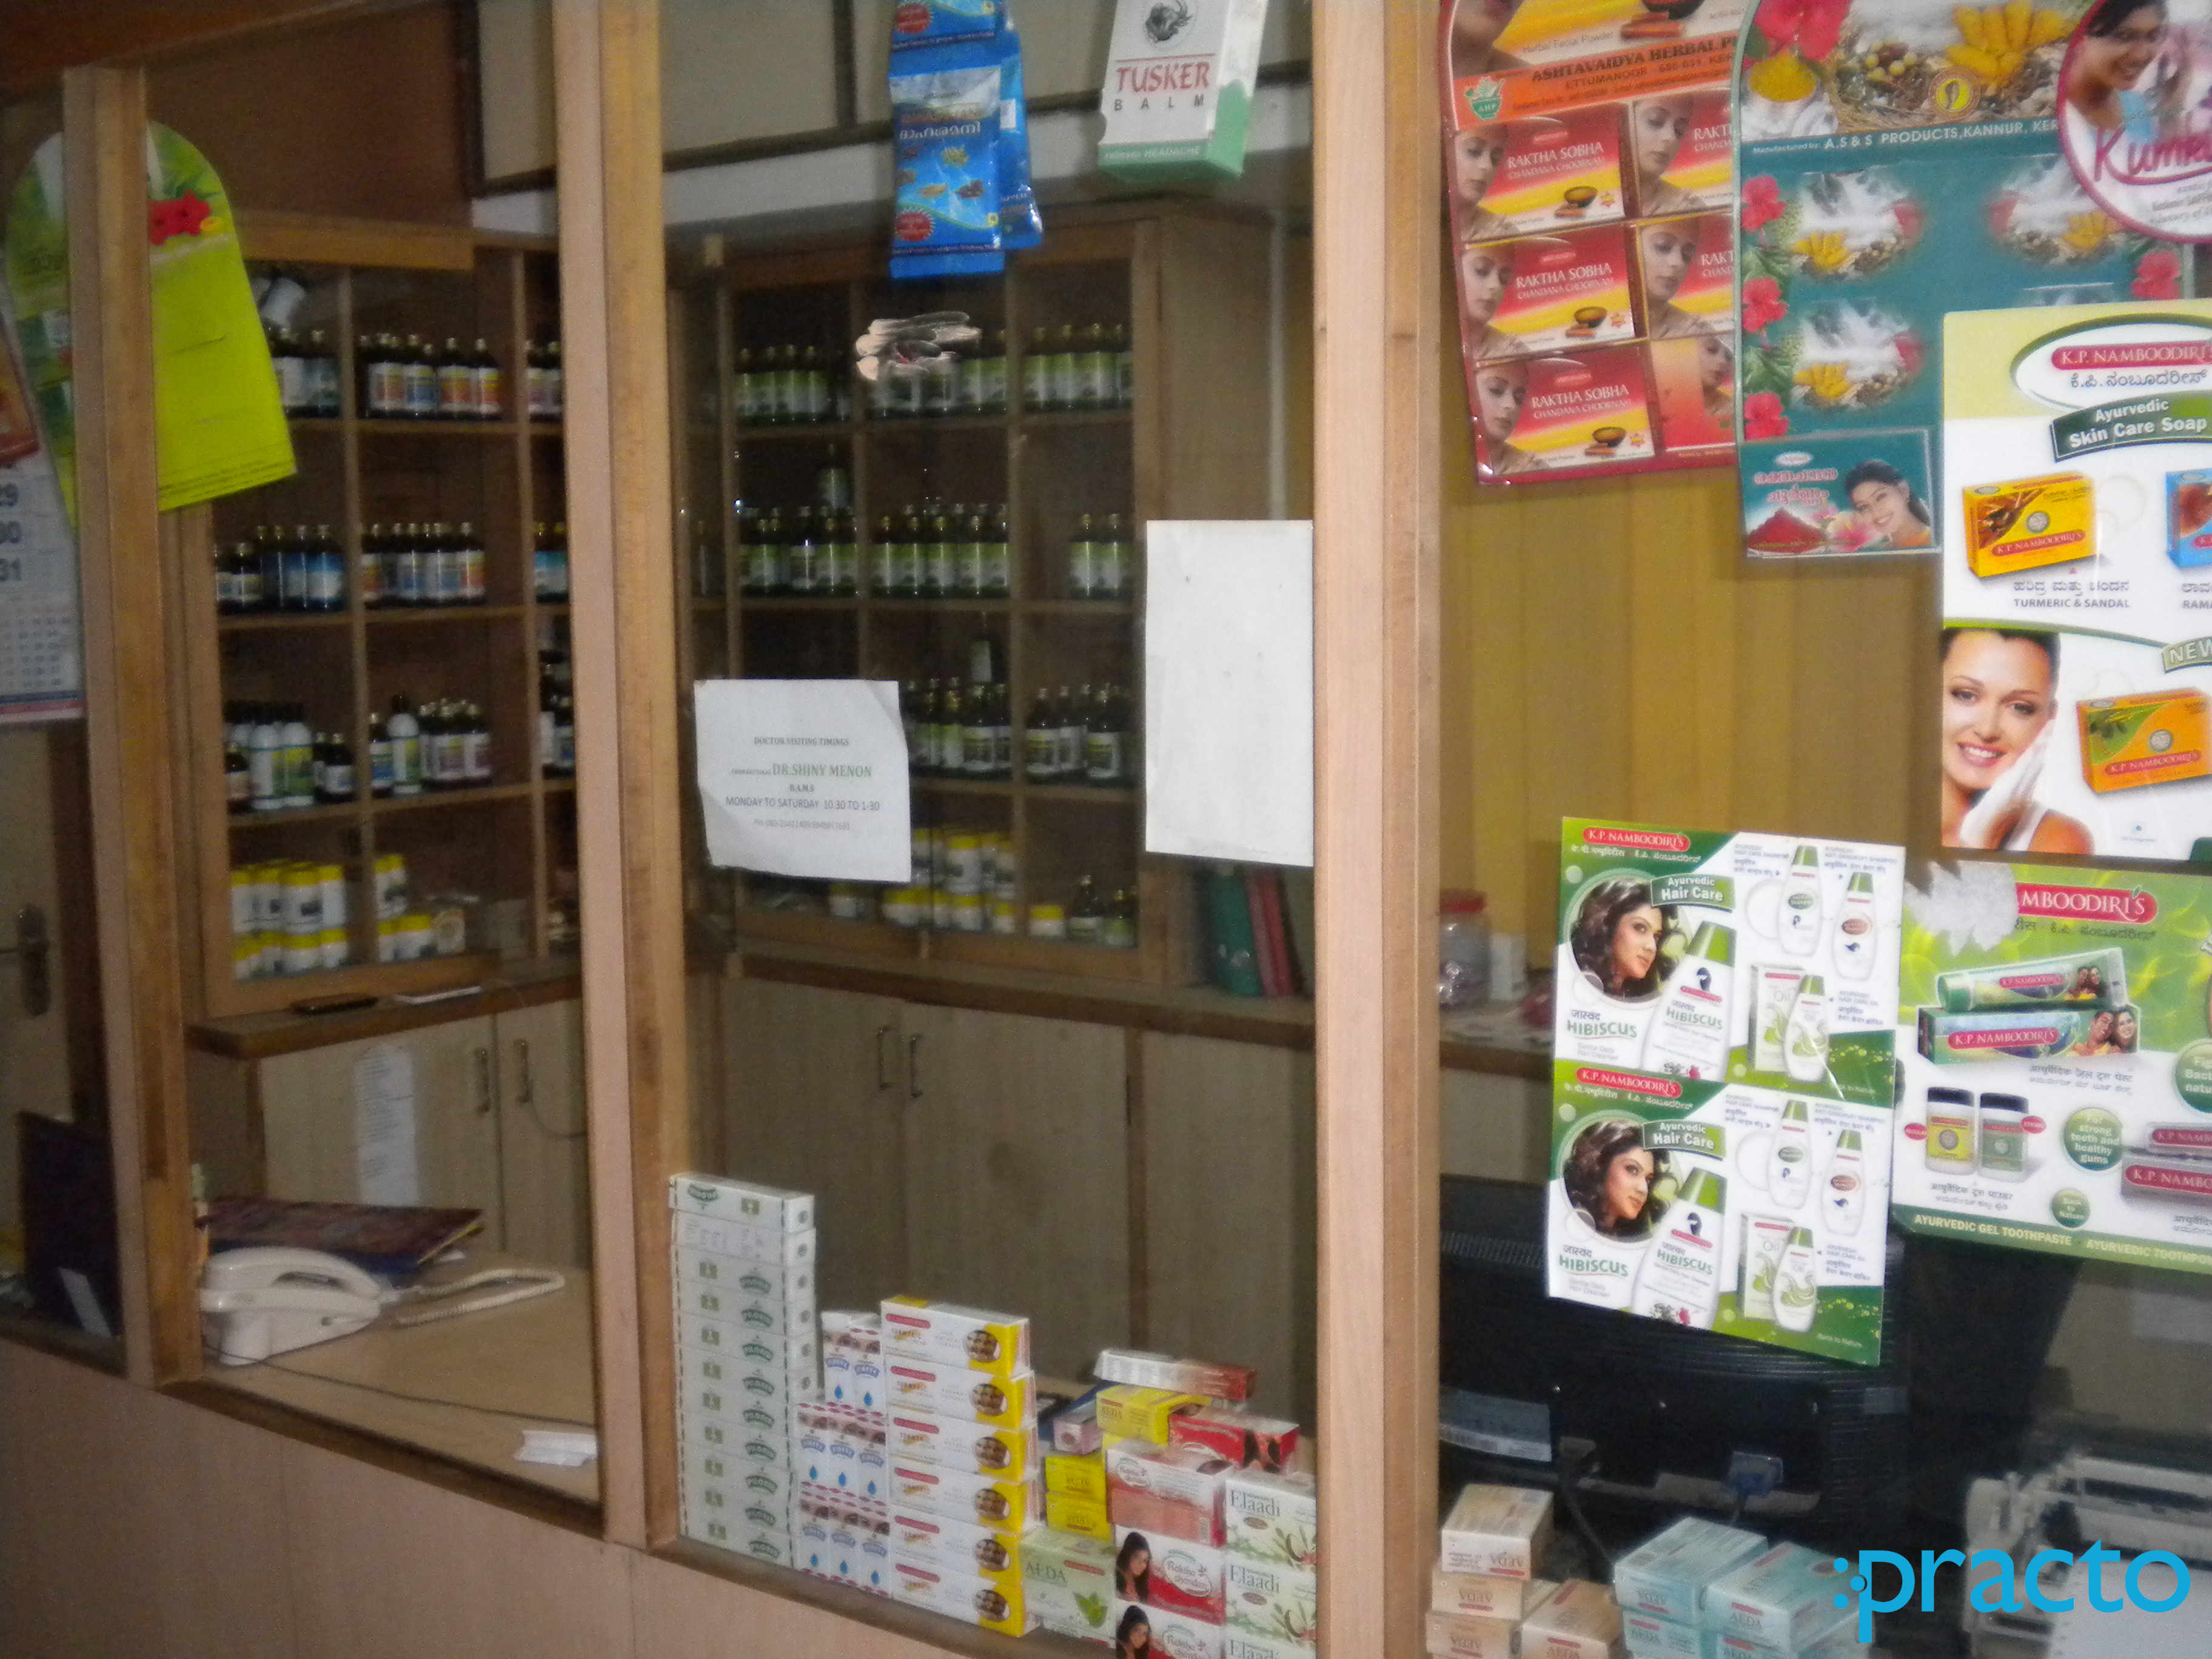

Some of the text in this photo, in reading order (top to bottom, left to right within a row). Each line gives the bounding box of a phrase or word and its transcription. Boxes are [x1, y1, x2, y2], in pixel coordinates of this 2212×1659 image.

[1532, 39, 1715, 82] ASHTAVAIDYA HERBAL
[1116, 62, 1210, 92] TUSKER
[1114, 95, 1204, 110] BALM
[1478, 104, 1497, 112] AHP
[1851, 135, 1862, 147] &
[1865, 134, 1873, 146] S
[1507, 142, 1604, 169] RAKTHA SOBHA
[1516, 263, 1613, 290] RAKTHA SOBHA
[2061, 350, 2090, 364] K.P.
[1531, 384, 1629, 409] RAKTHA SOBHA
[2095, 398, 2170, 423] Ayurvedic
[2069, 416, 2208, 449] Skin Care Soap
[2014, 598, 2130, 608] TURMERIC & SANDAL
[754, 737, 850, 746] DOCTOR VISITING TIMINGS
[829, 764, 872, 777] MENON
[725, 796, 762, 806] MONDAY
[765, 797, 776, 806] TO
[778, 798, 819, 809] SATURDAY
[848, 800, 859, 811] TO
[1589, 830, 1684, 850] K.P. NAMBOODIRI'S
[1668, 877, 1715, 887] Ayurvedic
[1661, 886, 1724, 902] Hair Care
[2022, 890, 2145, 922] MBOODIRI'S
[1666, 1007, 1723, 1030] HIBISCUS
[1566, 1019, 1638, 1039] HIBISCUS
[1582, 1070, 1677, 1096] K.P. NAMBOODIRI'S
[1660, 1122, 1708, 1134] Ayurvedic
[2079, 1125, 2112, 1136] strong
[1653, 1132, 1715, 1150] Hair Care
[2071, 1131, 2120, 1145] teeth and
[2074, 1143, 2112, 1155] healthy
[2080, 1154, 2108, 1164] gums
[1914, 1213, 1977, 1232] AYURVEDIC
[1979, 1222, 2000, 1236] GEL
[2003, 1226, 2073, 1247] TOOTHPASTE
[2086, 1238, 2151, 1257] AYURVEDIC
[1559, 1255, 1629, 1278] HIBISCUS
[1657, 1248, 1714, 1275] HIBISCUS
